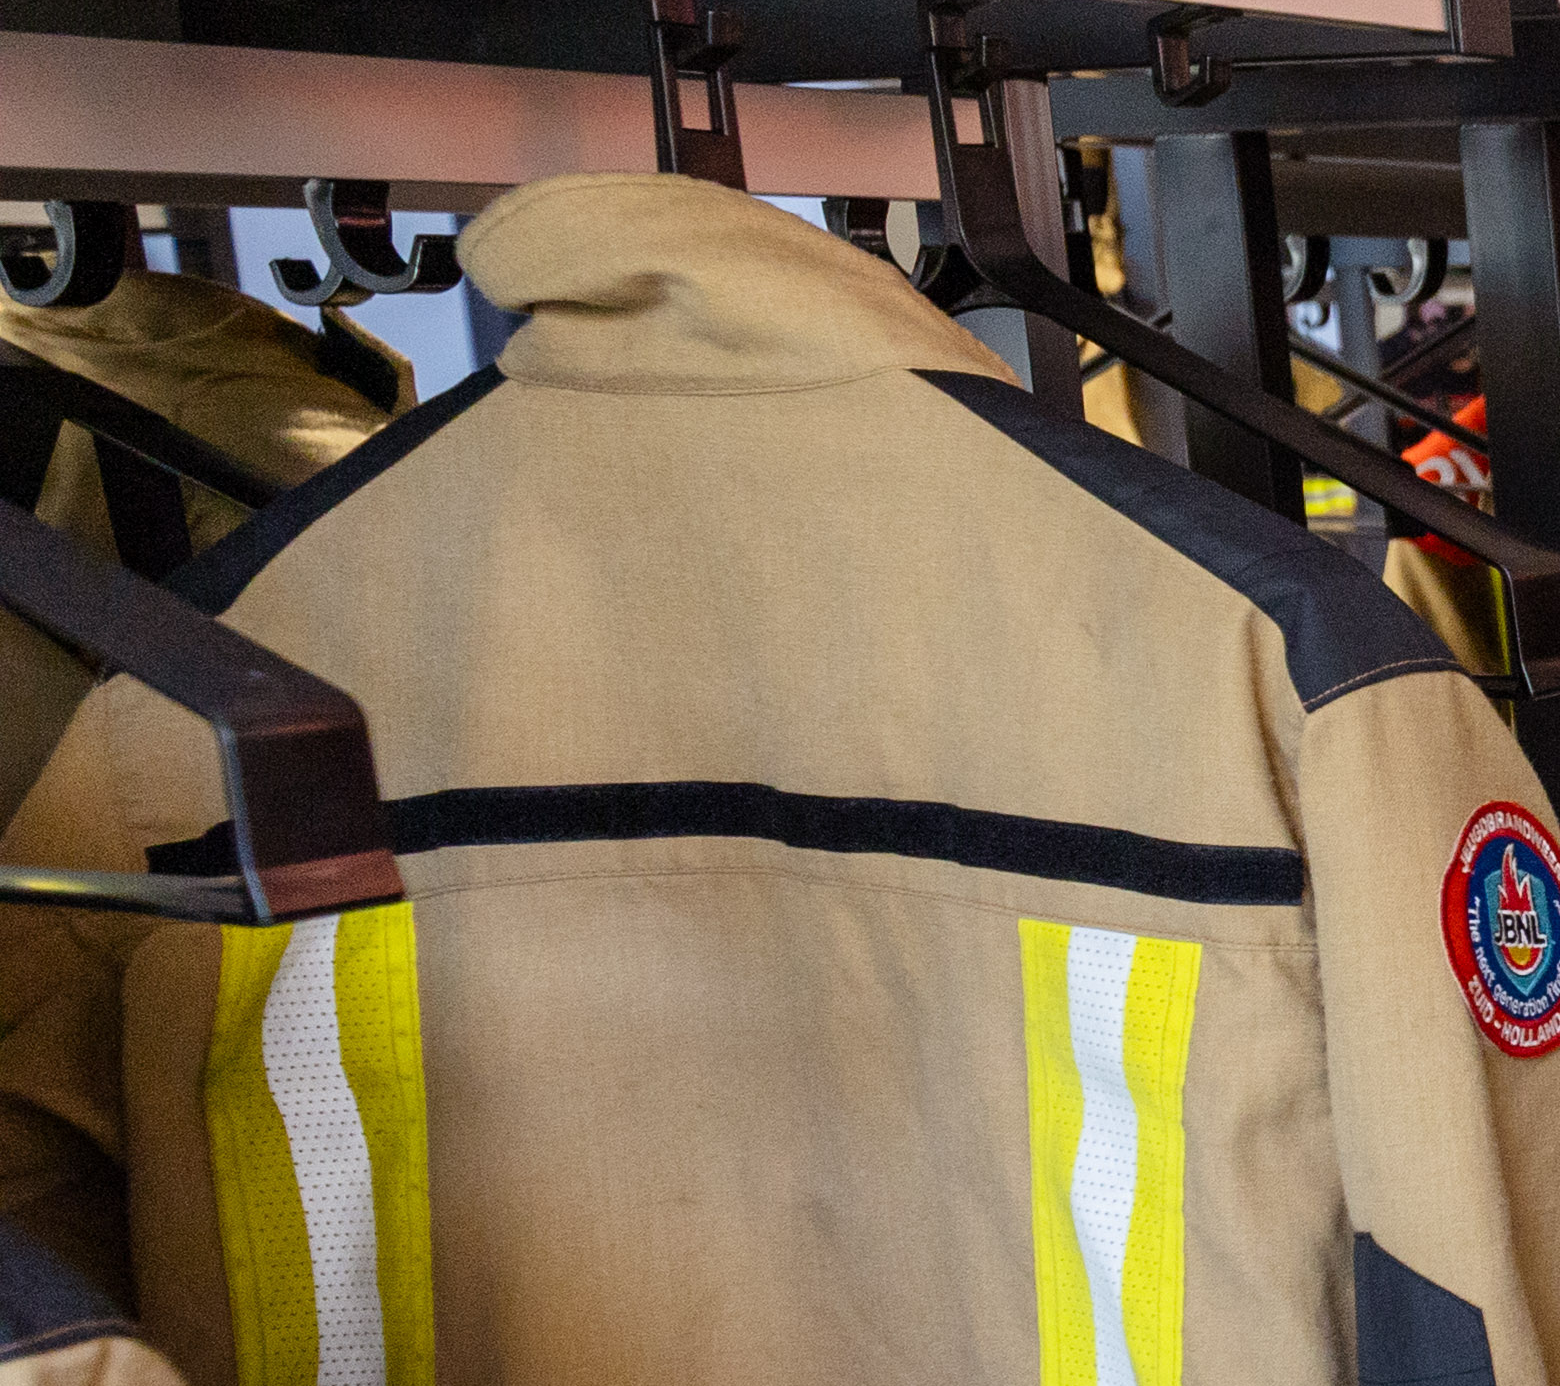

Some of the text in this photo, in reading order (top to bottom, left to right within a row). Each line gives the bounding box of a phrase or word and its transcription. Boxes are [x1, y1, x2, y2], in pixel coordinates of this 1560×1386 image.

[1494, 909, 1548, 949] JBNL
[1475, 946, 1497, 988] next
[1493, 983, 1549, 1017] generation
